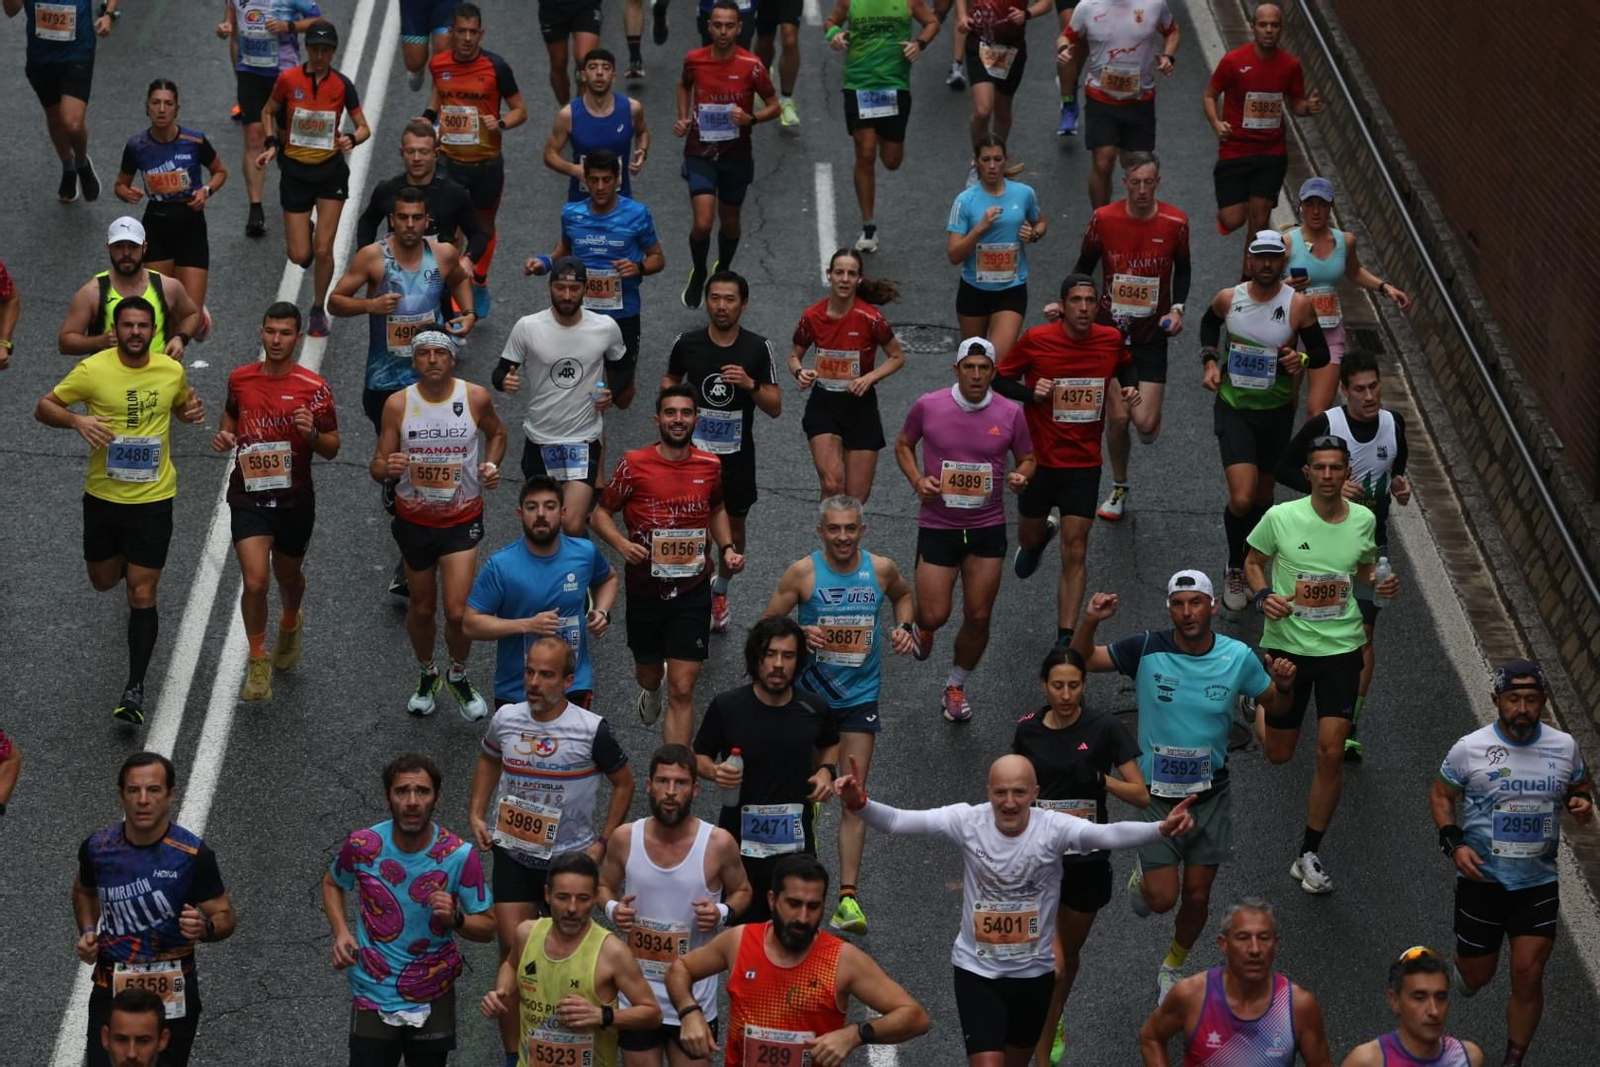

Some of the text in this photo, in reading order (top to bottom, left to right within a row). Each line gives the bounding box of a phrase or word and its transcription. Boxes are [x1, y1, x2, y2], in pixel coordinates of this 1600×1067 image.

[41, 13, 66, 26] 4792
[445, 115, 468, 128] 5007
[983, 252, 1012, 266] 3993
[1118, 284, 1148, 300] 6345
[819, 361, 849, 374] 4478
[1234, 354, 1265, 371] 2445
[1060, 390, 1093, 404] 4375
[701, 420, 731, 435] 3327
[116, 445, 150, 462] 2488
[409, 445, 468, 455] GRANADA
[249, 454, 280, 471] 5363
[417, 466, 450, 481] 5575
[948, 474, 981, 490] 4389
[661, 541, 694, 557] 6156
[847, 592, 876, 603] ULSA
[1303, 583, 1336, 600] 3998
[826, 629, 862, 645] 3687
[1161, 758, 1199, 776] 2592
[505, 809, 543, 835] 3989
[751, 818, 789, 836] 2471
[1502, 816, 1541, 834] 2950
[153, 868, 178, 880] HOKA
[108, 876, 152, 901] MARATÓN
[983, 916, 1023, 935] 5401
[635, 931, 674, 954] 3934
[536, 1044, 577, 1067] 5323
[757, 1044, 791, 1067] 289
